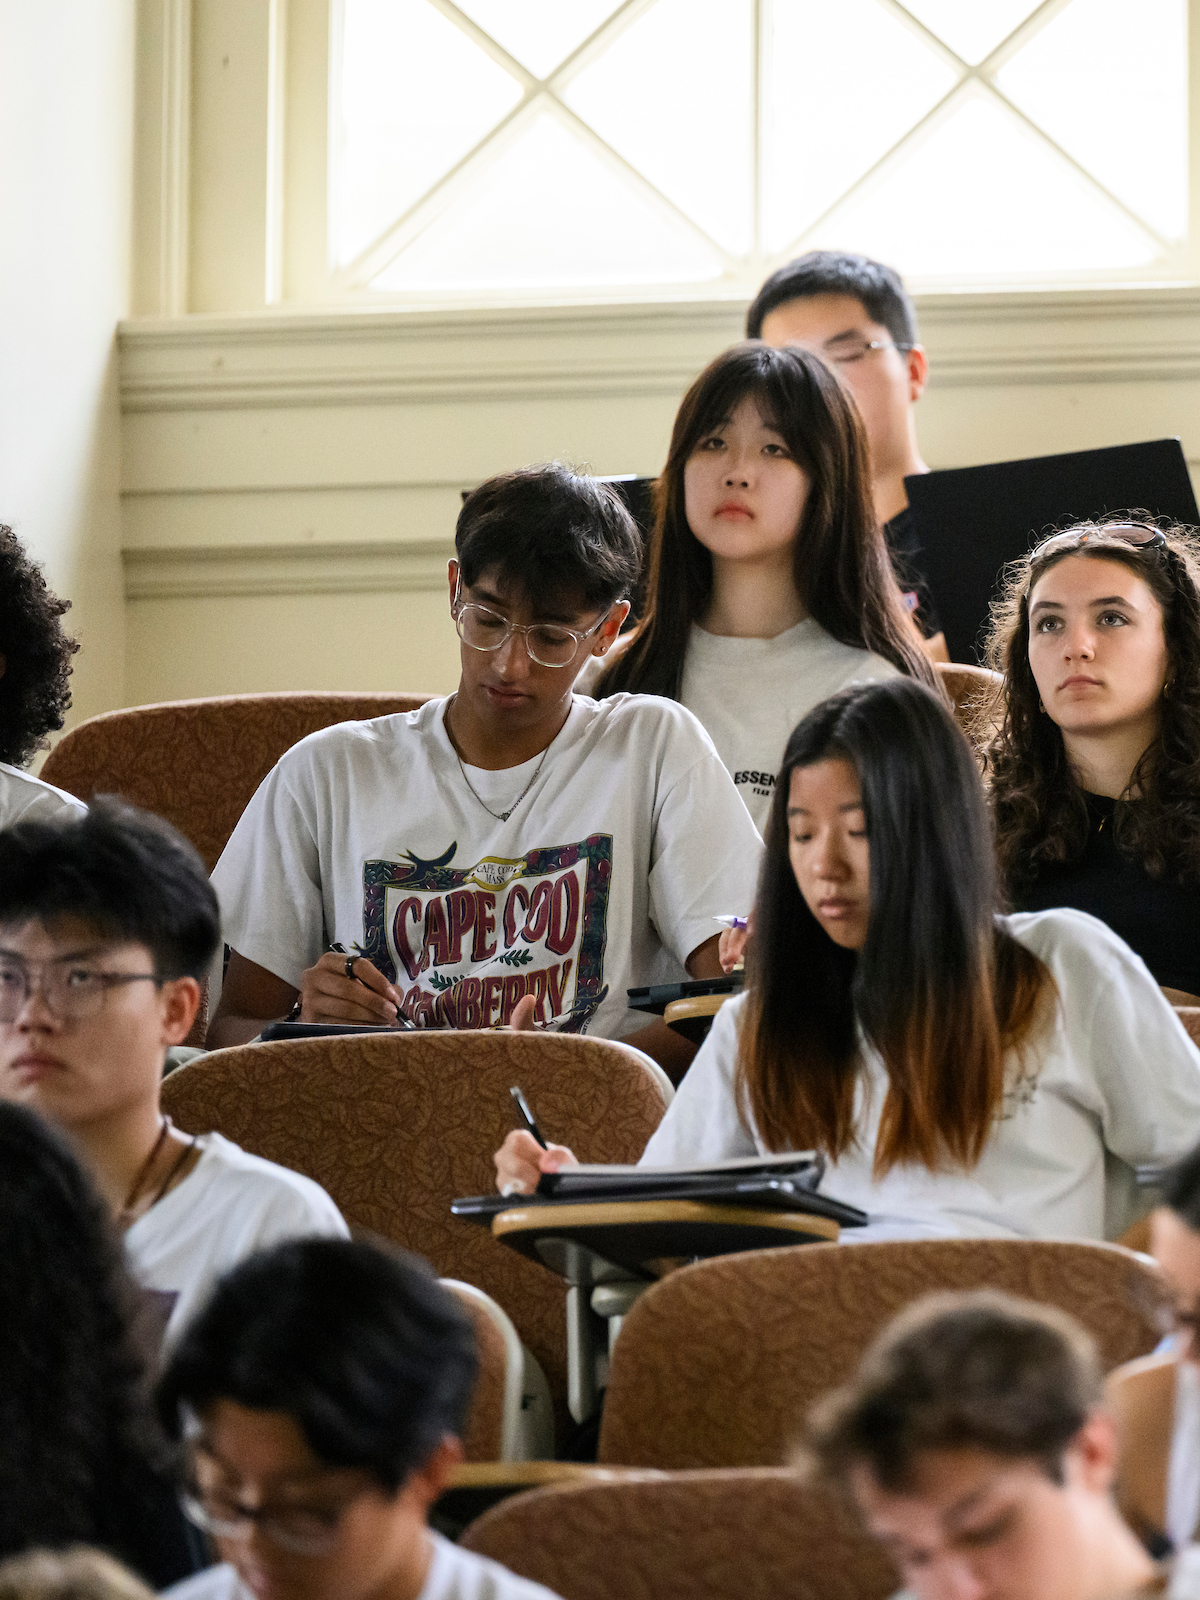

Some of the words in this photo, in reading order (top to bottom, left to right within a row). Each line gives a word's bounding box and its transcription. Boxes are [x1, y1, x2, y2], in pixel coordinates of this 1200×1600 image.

[477, 863, 496, 875] CAPE
[486, 874, 505, 884] MASS
[393, 889, 497, 981] CAPE
[503, 870, 580, 955] COD
[400, 958, 573, 1030] RANBERRY
